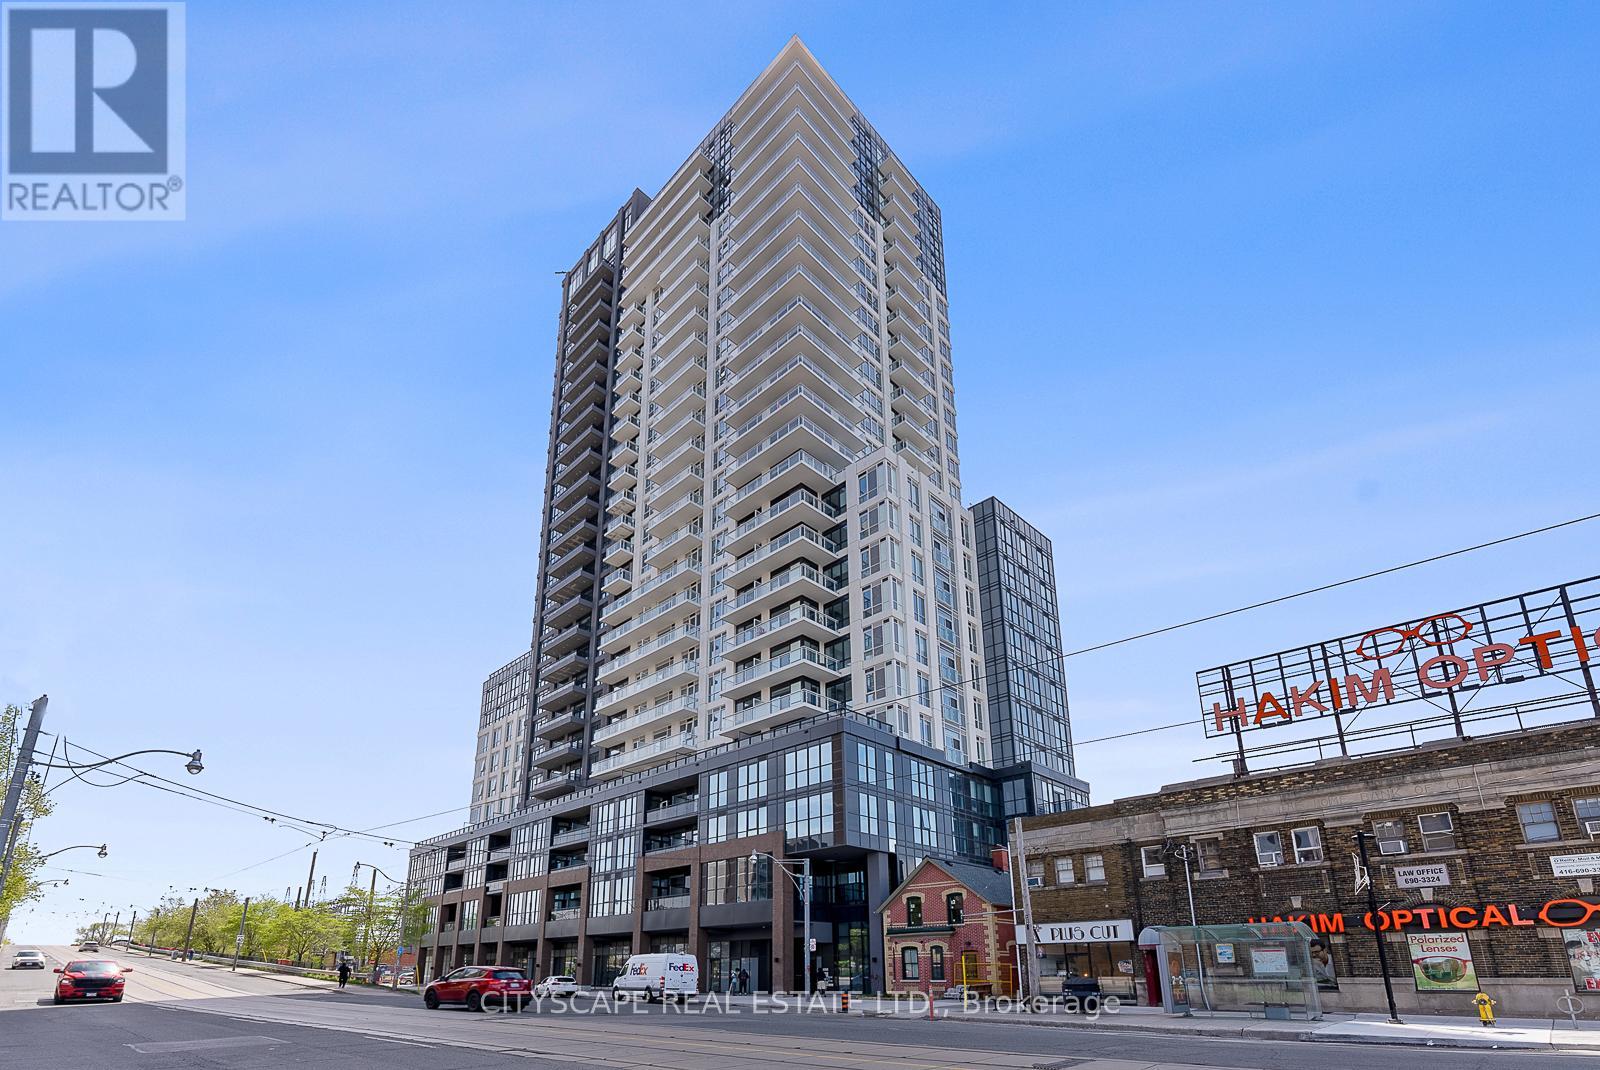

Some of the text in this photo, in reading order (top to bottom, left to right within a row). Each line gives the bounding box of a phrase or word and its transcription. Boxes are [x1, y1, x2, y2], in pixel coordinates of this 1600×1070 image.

[1213, 625, 1600, 732] HAKIM OPTI
[1414, 783, 1433, 795] OF
[1398, 867, 1445, 877] LAW OFFICE
[1404, 875, 1441, 885] 690-3324
[1248, 903, 1535, 933] KIM OPTICAL
[1050, 926, 1085, 941] PLUS
[1090, 924, 1120, 940] CUT
[1410, 933, 1465, 944] Polarized
[1421, 944, 1458, 953] Lenses
[630, 963, 648, 976] FedEx
[668, 962, 695, 972] FedEx
